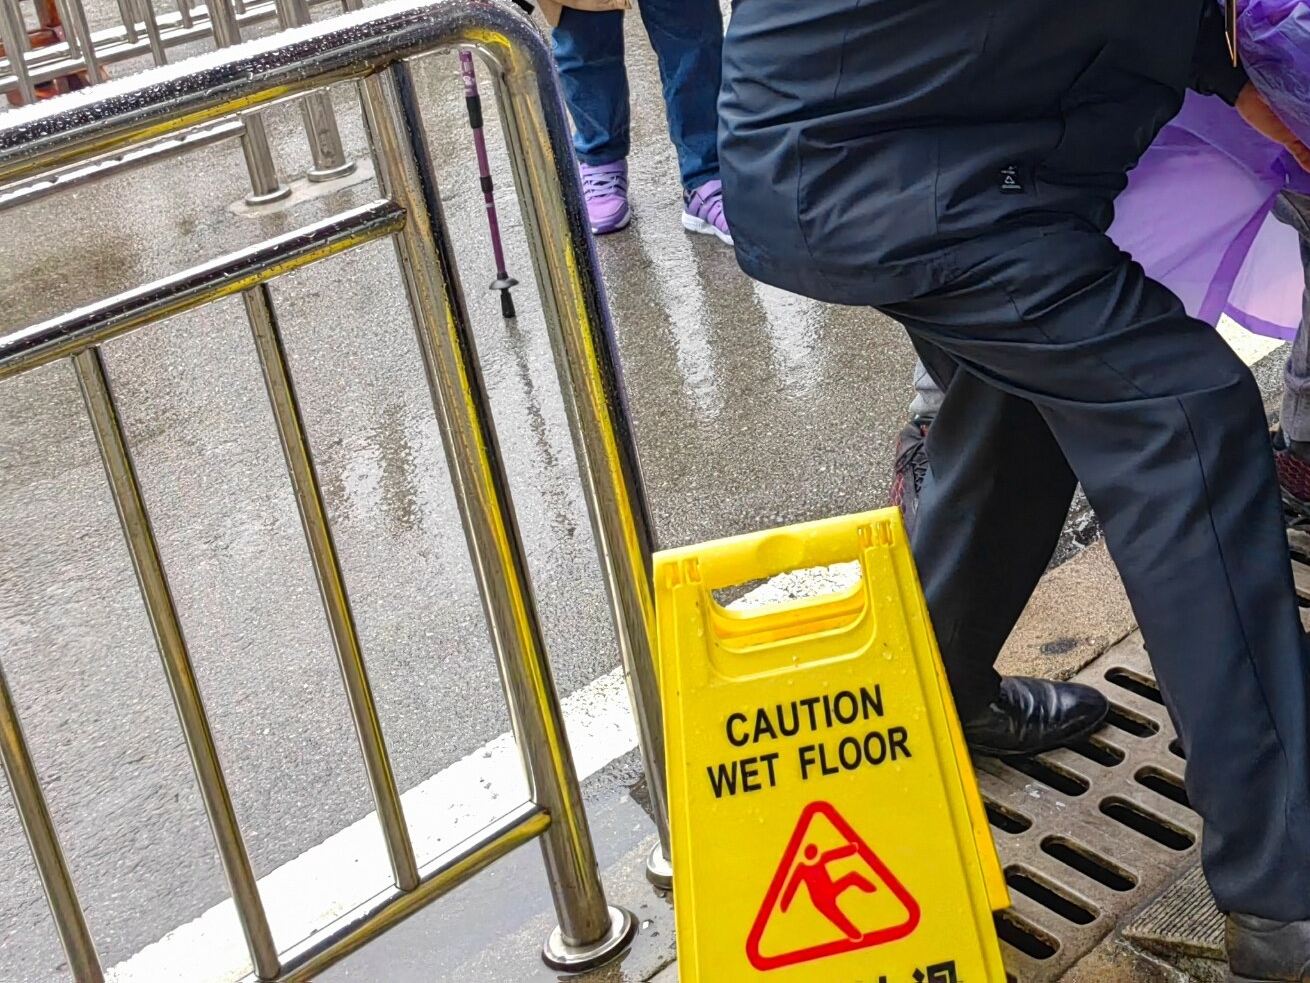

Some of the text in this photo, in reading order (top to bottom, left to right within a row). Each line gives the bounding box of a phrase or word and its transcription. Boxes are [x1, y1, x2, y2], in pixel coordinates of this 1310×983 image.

[726, 684, 884, 747] CAUTION
[706, 726, 912, 799] WET FLOOR
